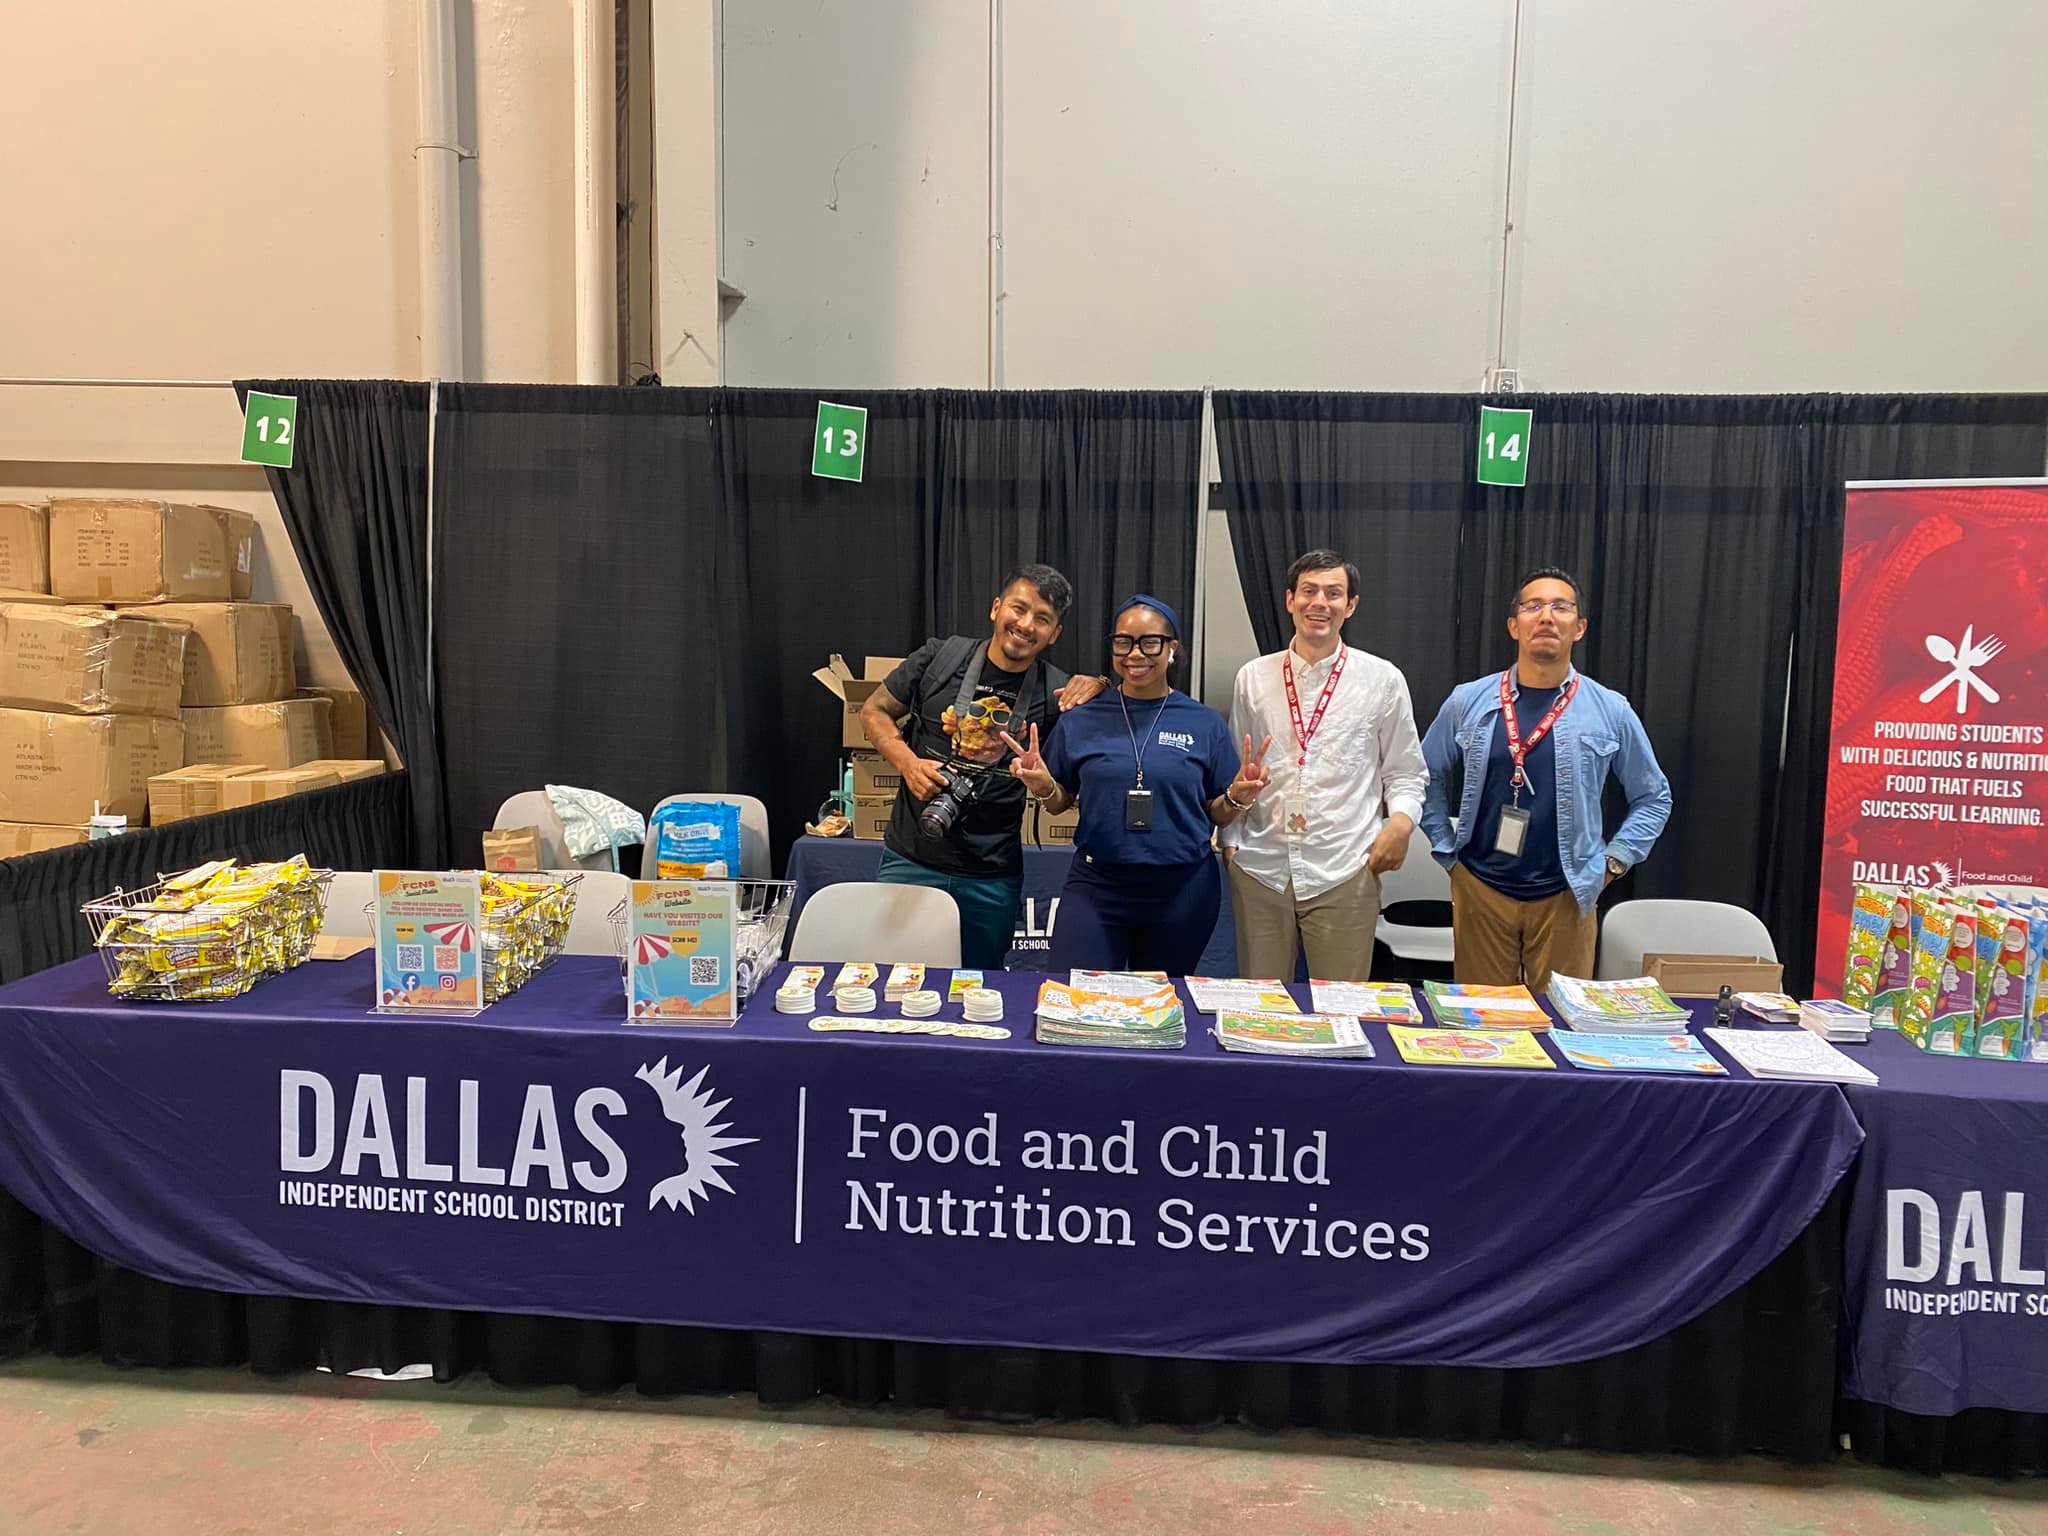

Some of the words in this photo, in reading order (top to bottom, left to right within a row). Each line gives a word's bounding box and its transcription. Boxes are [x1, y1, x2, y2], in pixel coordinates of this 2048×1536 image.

[256, 415, 291, 445] 12
[823, 426, 858, 457] 13
[1485, 431, 1521, 462] 14
[1874, 721, 1958, 741] PROVIDING
[1960, 724, 2044, 745] STUDENTS
[1840, 746, 1879, 764] WITH
[1883, 748, 1963, 769] DELICIOUS
[1966, 752, 1978, 769] &
[1886, 775, 1926, 793] FOOD
[1930, 777, 1971, 795] THAT
[1973, 779, 2024, 798] FUELS
[1860, 799, 1958, 822] SUCCESSFUL
[1961, 804, 2045, 826] LEARNING.
[402, 880, 437, 891] FCNS
[1852, 860, 1931, 887] DALLAS
[1961, 871, 1986, 880] Food
[1987, 873, 2006, 881] and
[2007, 873, 2033, 883] Child
[656, 889, 692, 900] FCNS
[1018, 939, 1050, 951] SCHOOL
[280, 1068, 629, 1194] DALLAS
[846, 1107, 1001, 1168] Food
[1020, 1120, 1139, 1175] and
[1158, 1125, 1331, 1186] Child
[279, 1180, 428, 1216] INDEPENDENT
[433, 1189, 519, 1221] SCHOOL
[525, 1197, 625, 1228] DISTRICT
[844, 1179, 1136, 1247] Nutrition
[1156, 1198, 1430, 1262] Services
